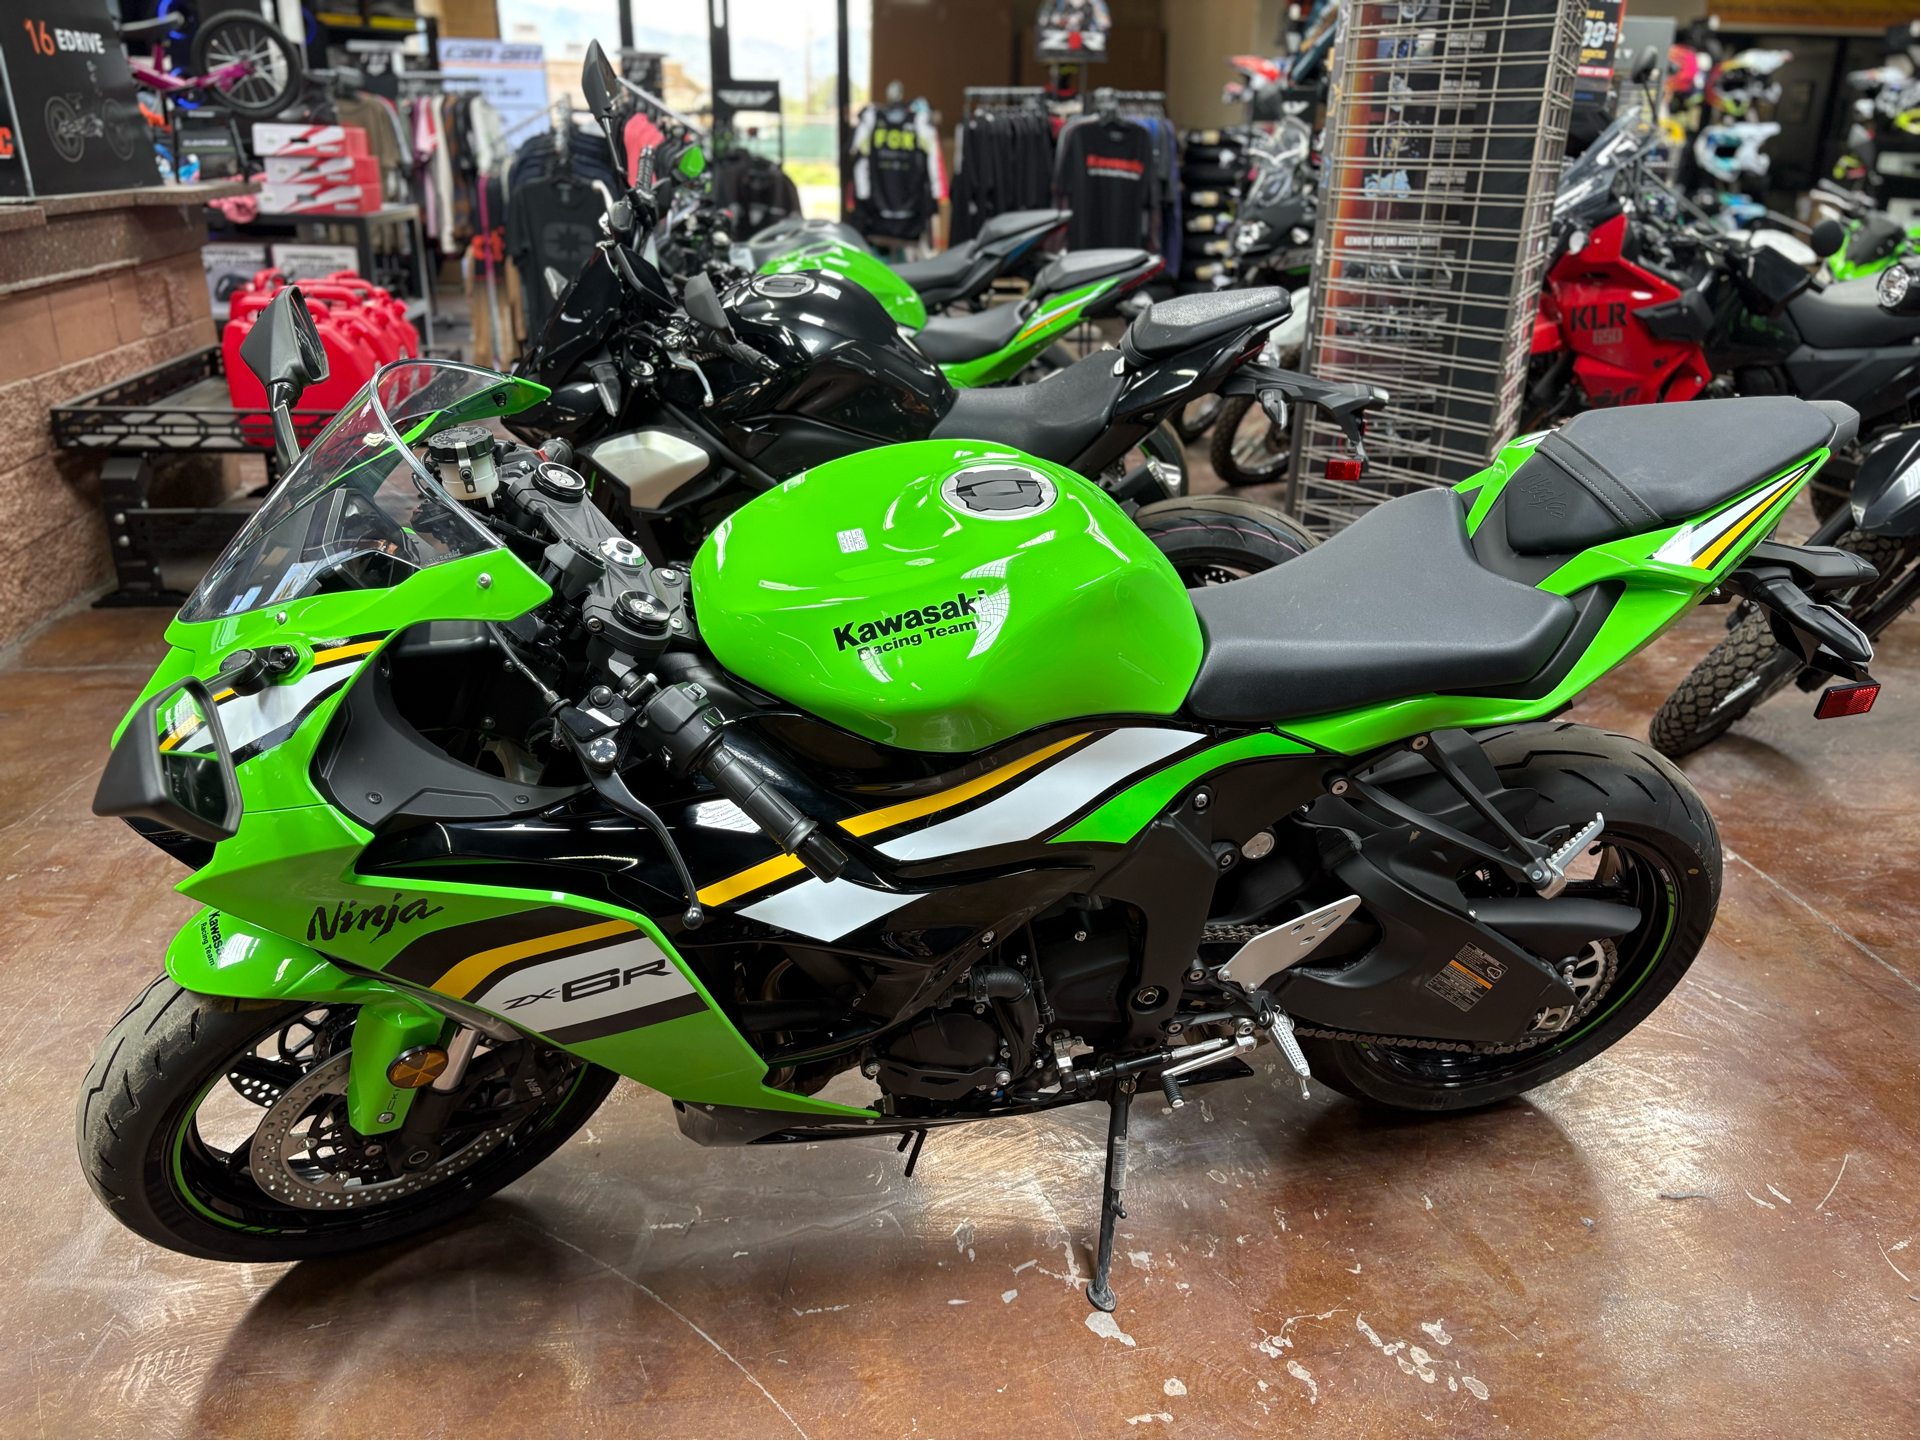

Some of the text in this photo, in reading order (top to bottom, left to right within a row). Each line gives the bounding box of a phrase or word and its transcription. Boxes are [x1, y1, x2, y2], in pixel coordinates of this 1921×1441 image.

[24, 18, 55, 56] 16
[874, 129, 916, 152] FOX
[1571, 303, 1628, 332] KLR
[1593, 327, 1623, 346] 650
[832, 589, 989, 652] Kawasaki
[857, 619, 977, 661] Racing Team
[307, 892, 444, 944] Ninja
[200, 921, 216, 967] Racing Team
[502, 959, 673, 1011] ZX-6R
